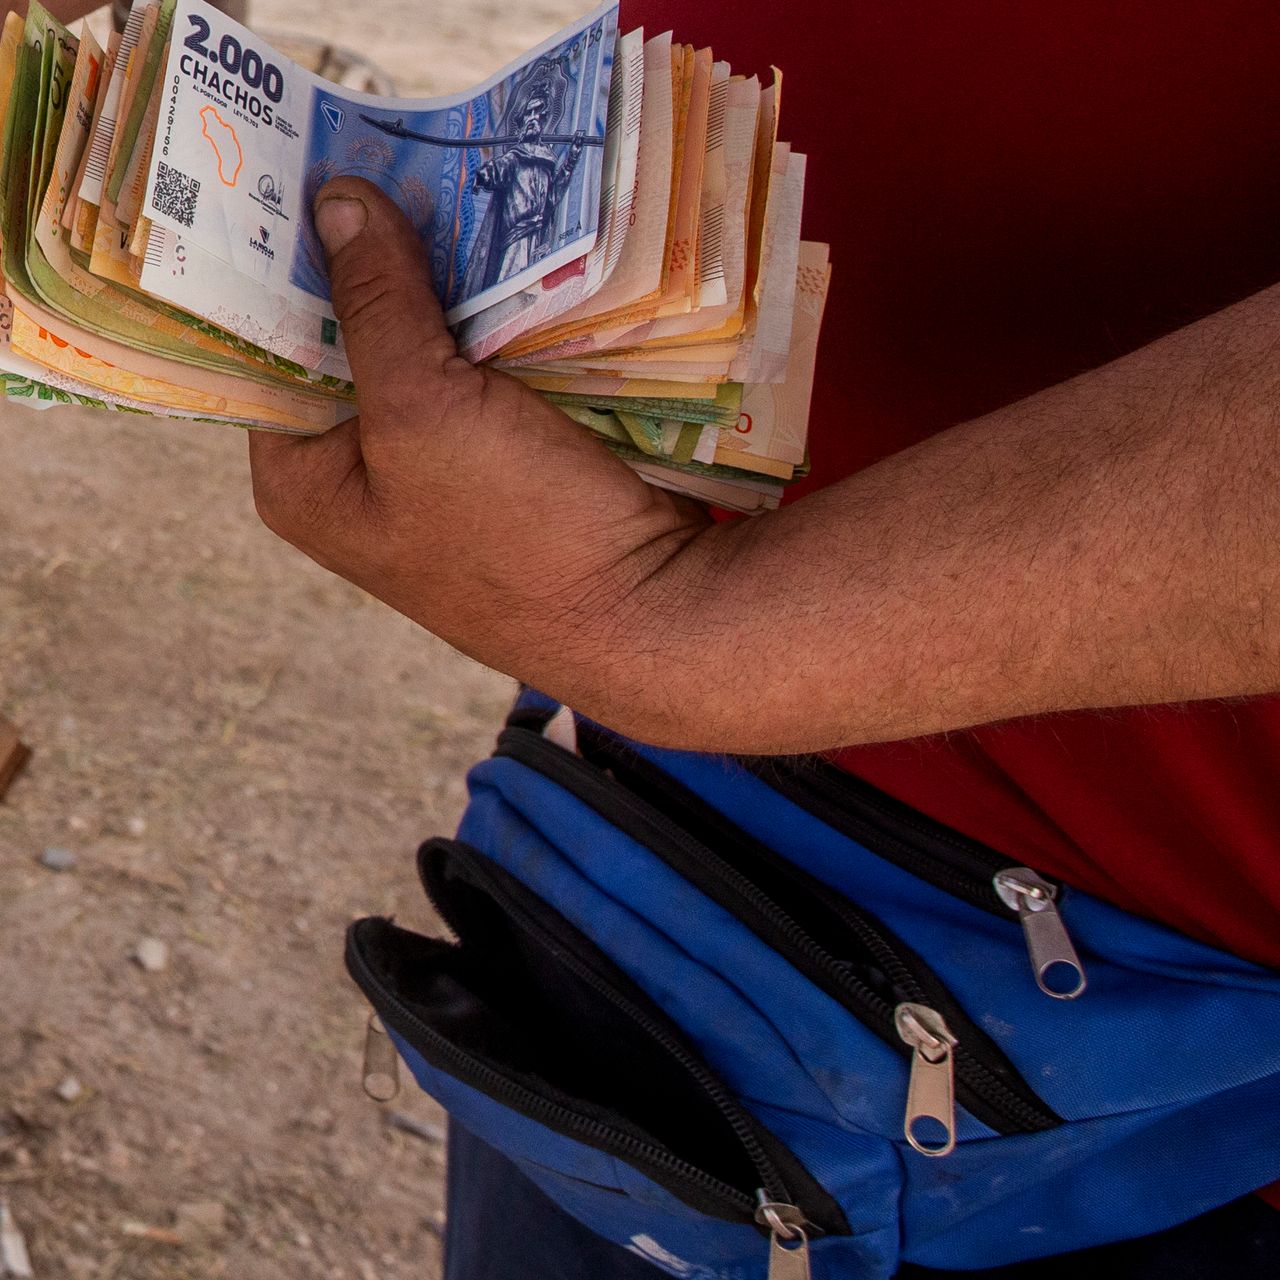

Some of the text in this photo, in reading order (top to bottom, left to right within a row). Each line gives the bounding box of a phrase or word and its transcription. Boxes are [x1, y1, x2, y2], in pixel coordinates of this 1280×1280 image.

[179, 54, 274, 126] CHACHOS
[183, 13, 284, 104] 2.000
[161, 74, 180, 157] 00429156
